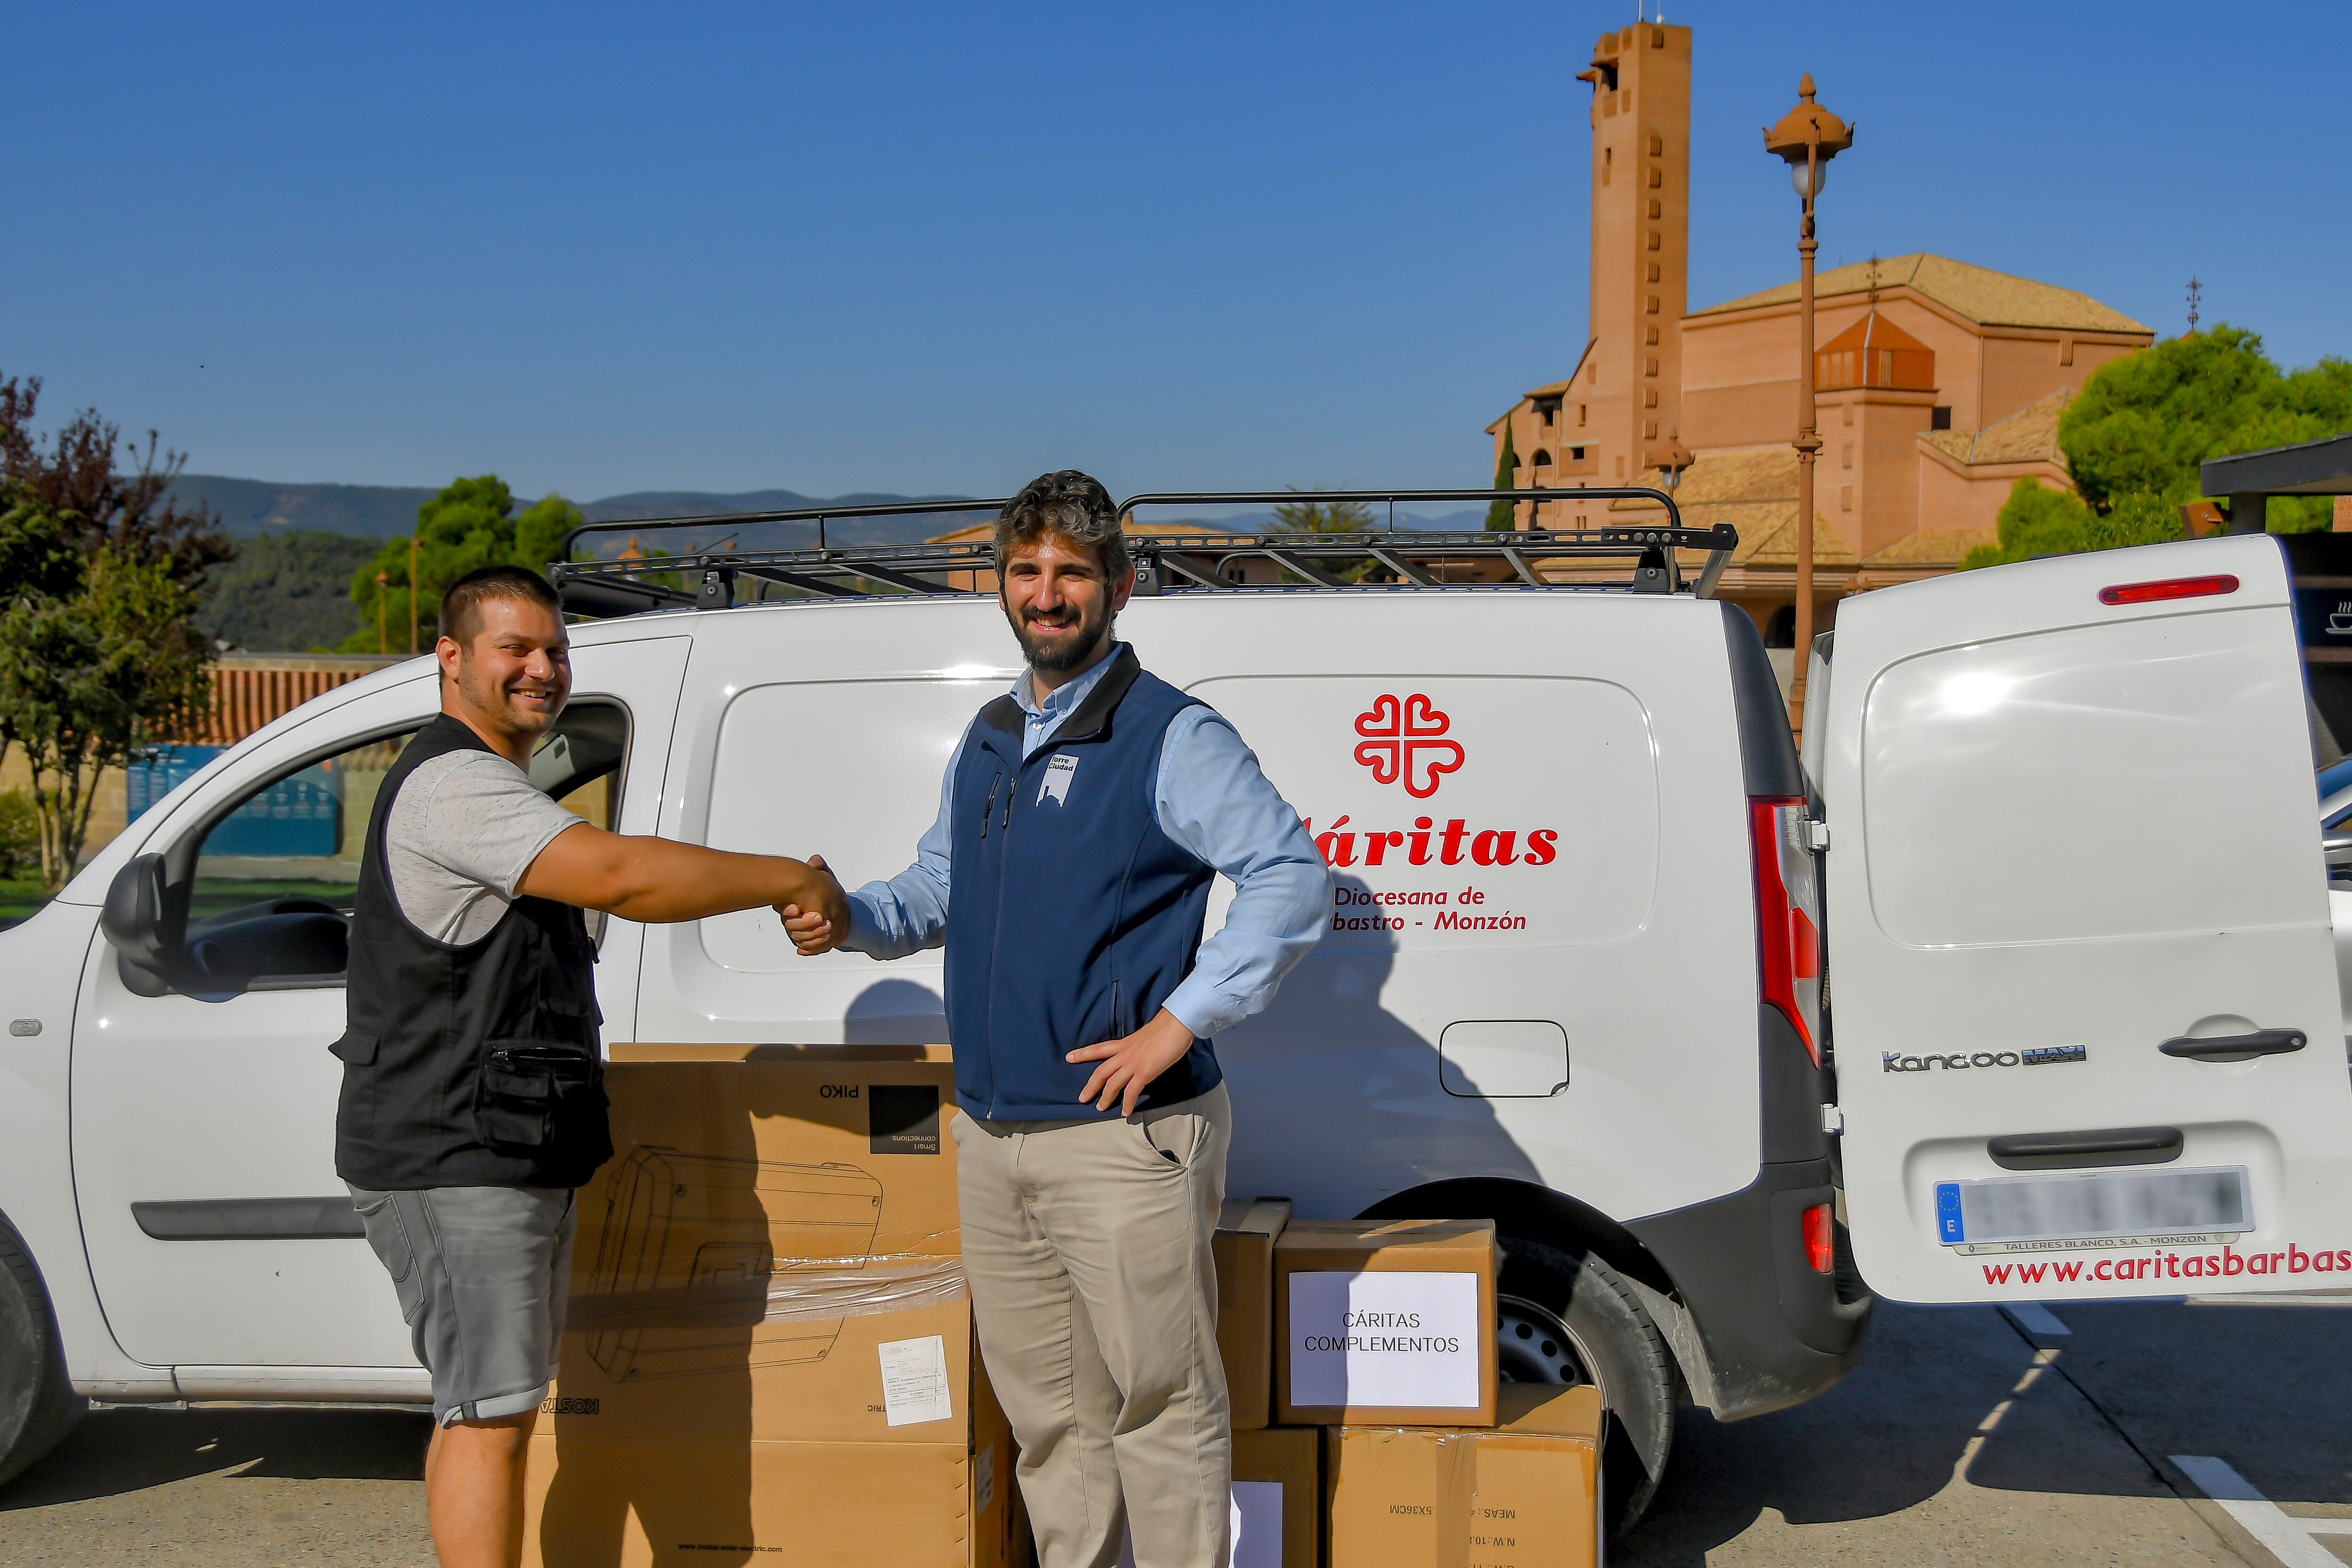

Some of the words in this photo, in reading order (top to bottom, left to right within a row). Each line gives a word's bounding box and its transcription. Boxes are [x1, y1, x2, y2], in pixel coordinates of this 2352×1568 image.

[1303, 814, 1558, 868] áritas
[1334, 887, 1447, 906] Diocesana
[1458, 886, 1485, 905] de
[1330, 912, 1405, 931] bastro
[1433, 911, 1526, 930] Monzón
[820, 1085, 859, 1098] PIKO
[1947, 1219, 1955, 1232] E
[2004, 1241, 2062, 1250] TALLERES
[2065, 1239, 2116, 1248] BLANCO,
[2150, 1235, 2206, 1244] MONZON
[1343, 1310, 1421, 1329] CÁRITAS
[1304, 1336, 1459, 1353] COMPLEMENTOS
